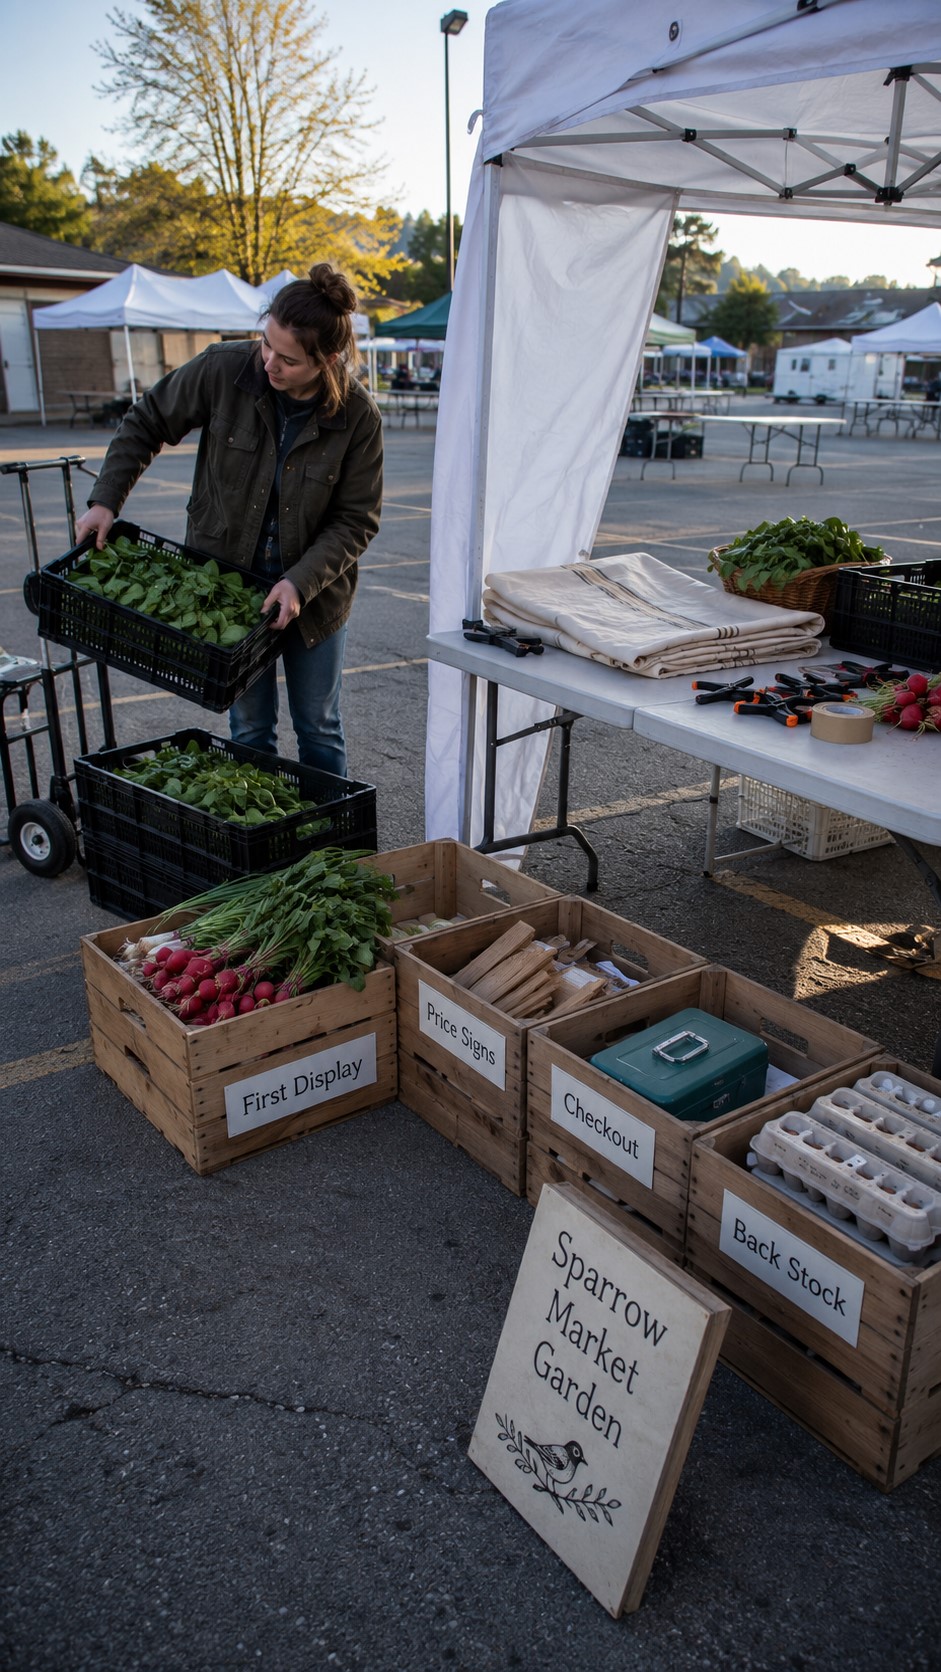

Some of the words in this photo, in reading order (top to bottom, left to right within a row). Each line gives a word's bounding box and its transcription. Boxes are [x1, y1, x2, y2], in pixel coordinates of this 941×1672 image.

[426, 1002, 458, 1038] Price
[461, 1026, 496, 1066] Signs
[243, 1084, 288, 1115] First
[294, 1059, 363, 1096] Display
[563, 1092, 640, 1160] Checkout
[551, 1230, 668, 1347] Sparrow
[733, 1218, 781, 1276] Back
[787, 1257, 847, 1317] Stock
[545, 1289, 640, 1395] Market
[533, 1340, 623, 1448] Garden
